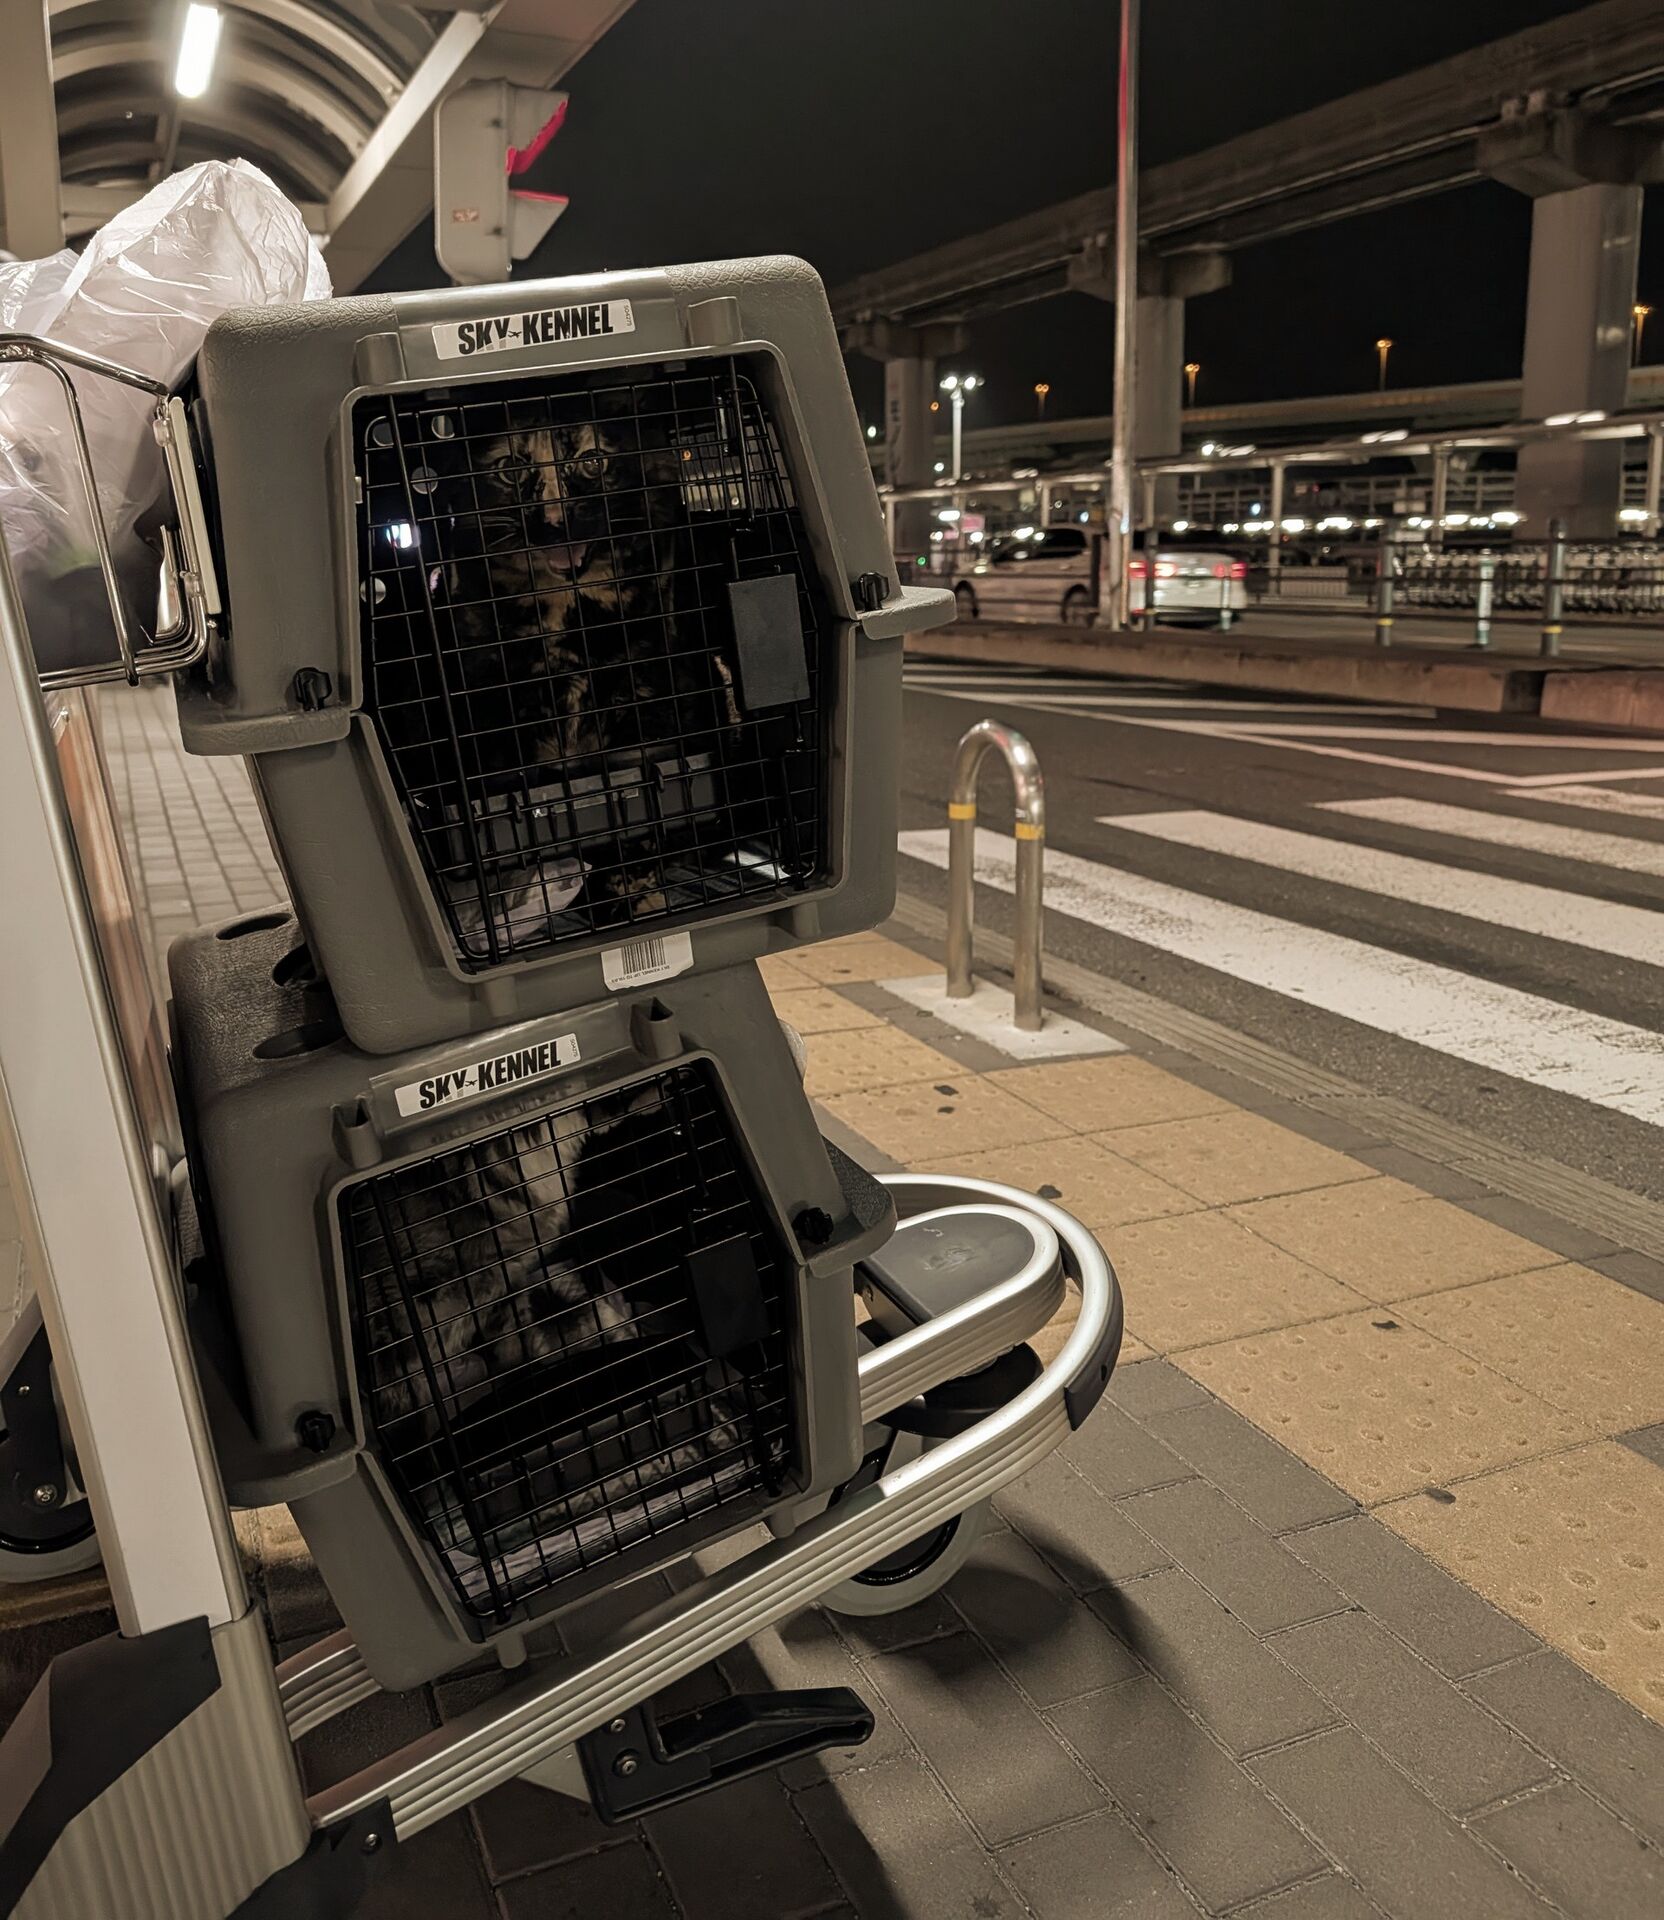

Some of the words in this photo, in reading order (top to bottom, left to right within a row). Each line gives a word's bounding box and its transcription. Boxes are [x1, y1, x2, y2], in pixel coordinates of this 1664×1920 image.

[458, 317, 510, 355] SKY
[523, 303, 613, 346] KENNEL
[419, 1069, 467, 1109] SKY
[478, 1040, 561, 1091] KENNEL
